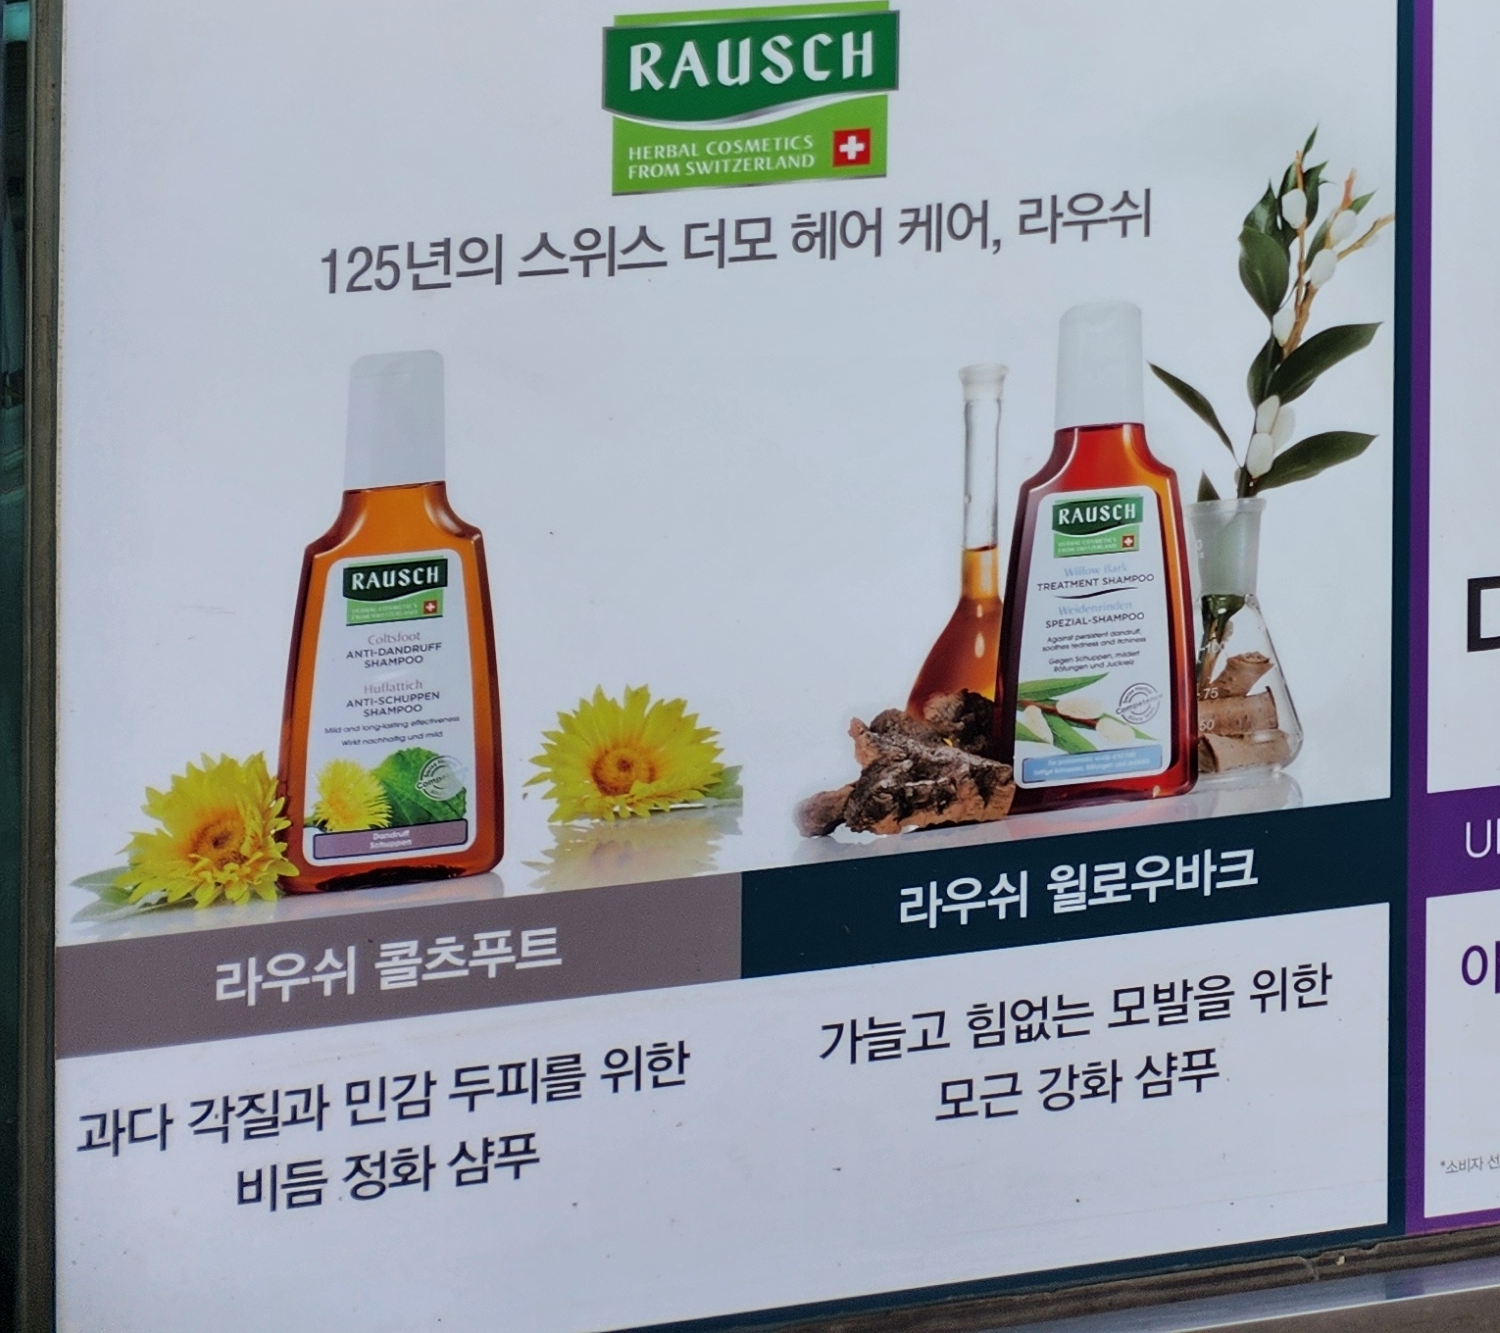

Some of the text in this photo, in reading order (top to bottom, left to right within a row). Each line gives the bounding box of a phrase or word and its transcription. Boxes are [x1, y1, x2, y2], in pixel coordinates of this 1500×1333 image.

[628, 30, 874, 92] RAUSCH
[628, 133, 814, 162] HERBAL COSMETICS
[628, 153, 816, 180] FROM SWITZERLAND
[320, 186, 1153, 295] 125년의 스위스 더모 헤어 케어, 라우쉬
[1058, 502, 1136, 525] RAUSCH
[351, 565, 440, 592] RAUSCH
[1037, 572, 1155, 592] TREATMENT SHAMPOO
[1045, 611, 1145, 629] SPEZIAL-SHAMPOO
[346, 642, 443, 660] ANTI-DANDRUFF
[364, 655, 424, 669] SHAMPOO
[345, 691, 440, 708] ANTI-SCHUPPEN
[362, 704, 423, 718] SHAMPOO
[900, 849, 1259, 929] 라우쉬 윌로우바크
[215, 927, 564, 1006] 라우쉬 콜츠푸트
[819, 961, 1334, 1067] 가늘고 힘없는 모발을 위한
[77, 1039, 692, 1158] 과다 각질과 민감 두피를 위한
[935, 1047, 1221, 1122] 모근 강화 샴푸
[236, 1133, 540, 1213] 비듬 정화 샴푸
